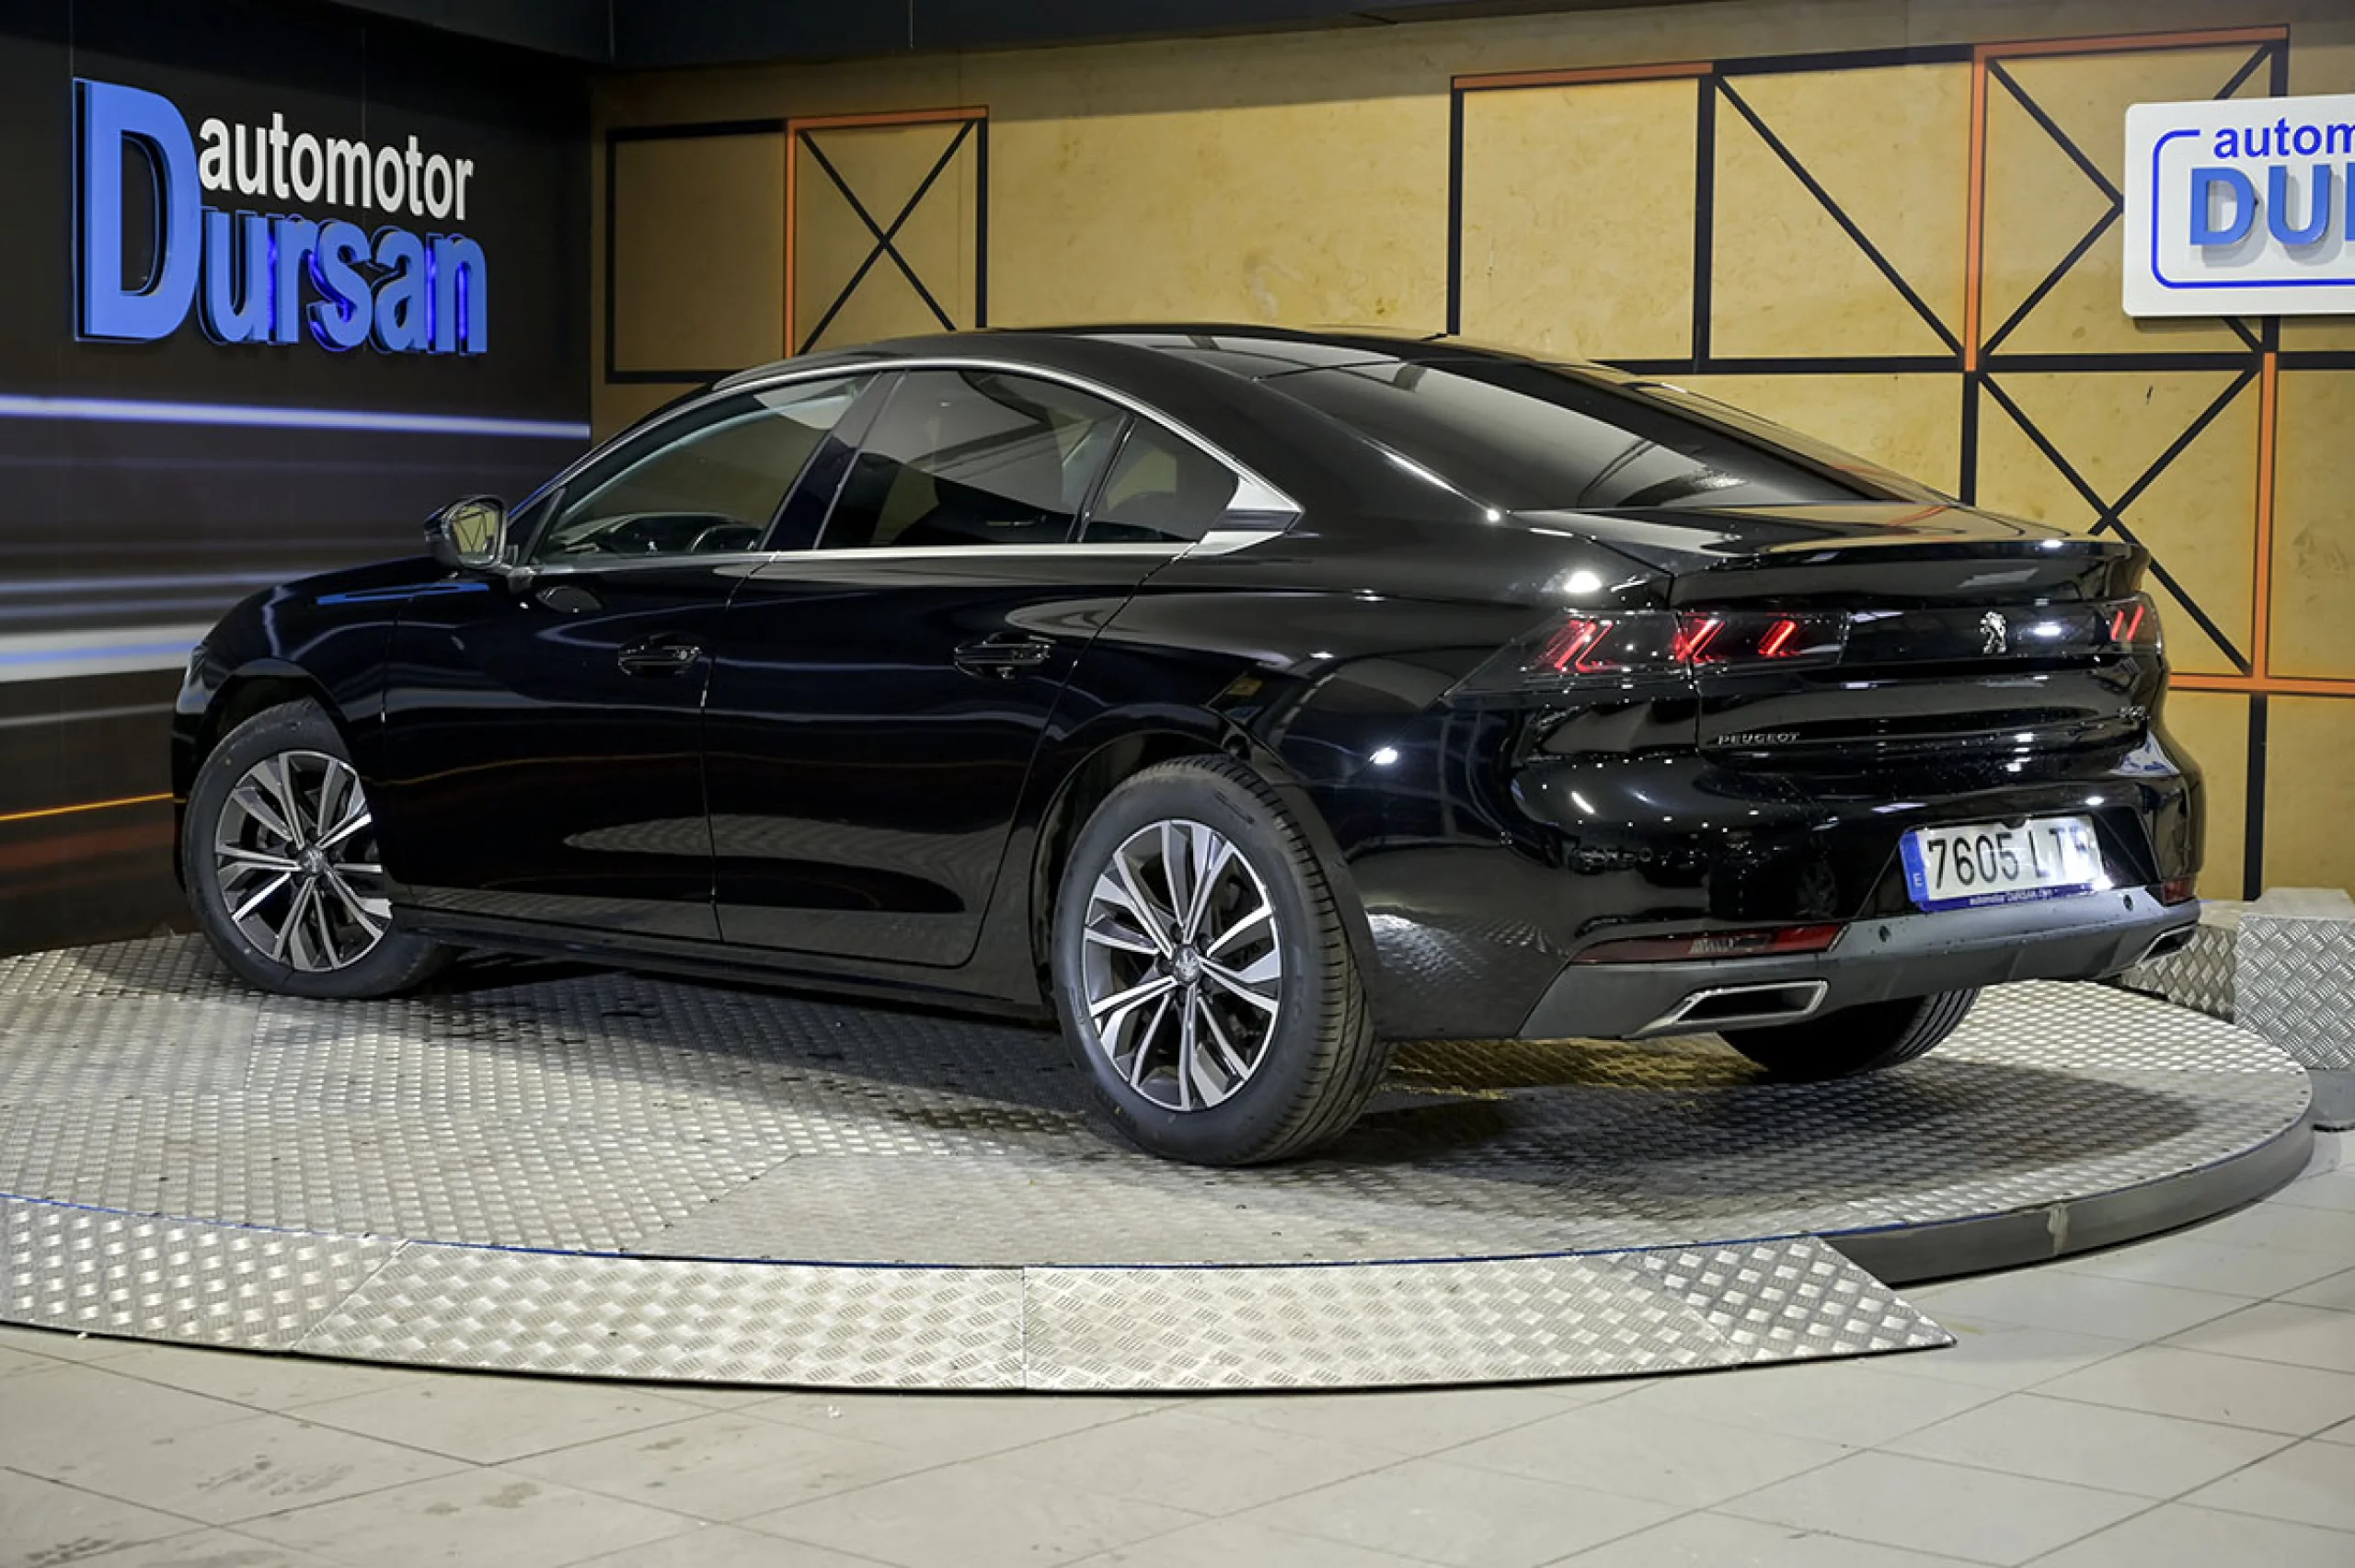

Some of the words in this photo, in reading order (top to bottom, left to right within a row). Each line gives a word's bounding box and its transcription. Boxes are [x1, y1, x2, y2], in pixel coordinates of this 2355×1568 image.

[199, 112, 475, 221] automotor
[2189, 161, 2355, 246] DU
[73, 77, 488, 355] Dursan
[1927, 831, 2018, 889] 7605
